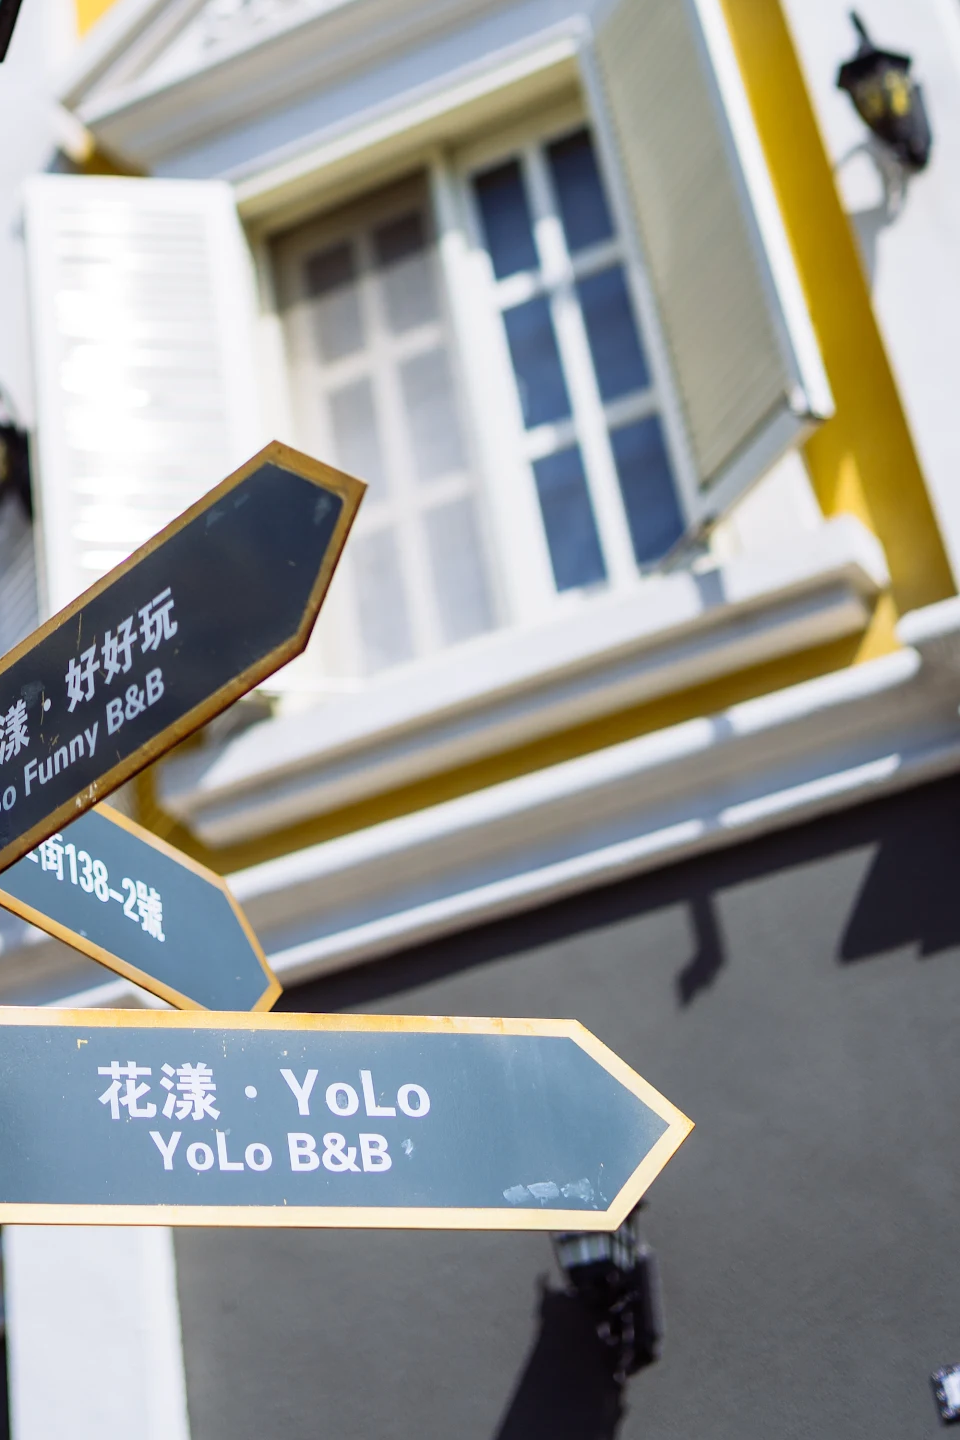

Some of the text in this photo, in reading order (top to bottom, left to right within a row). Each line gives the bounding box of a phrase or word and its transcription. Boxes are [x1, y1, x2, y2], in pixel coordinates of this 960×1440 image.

[23, 720, 99, 797] Funny
[105, 667, 165, 736] B&B
[149, 1129, 393, 1173] YoLo B&B
